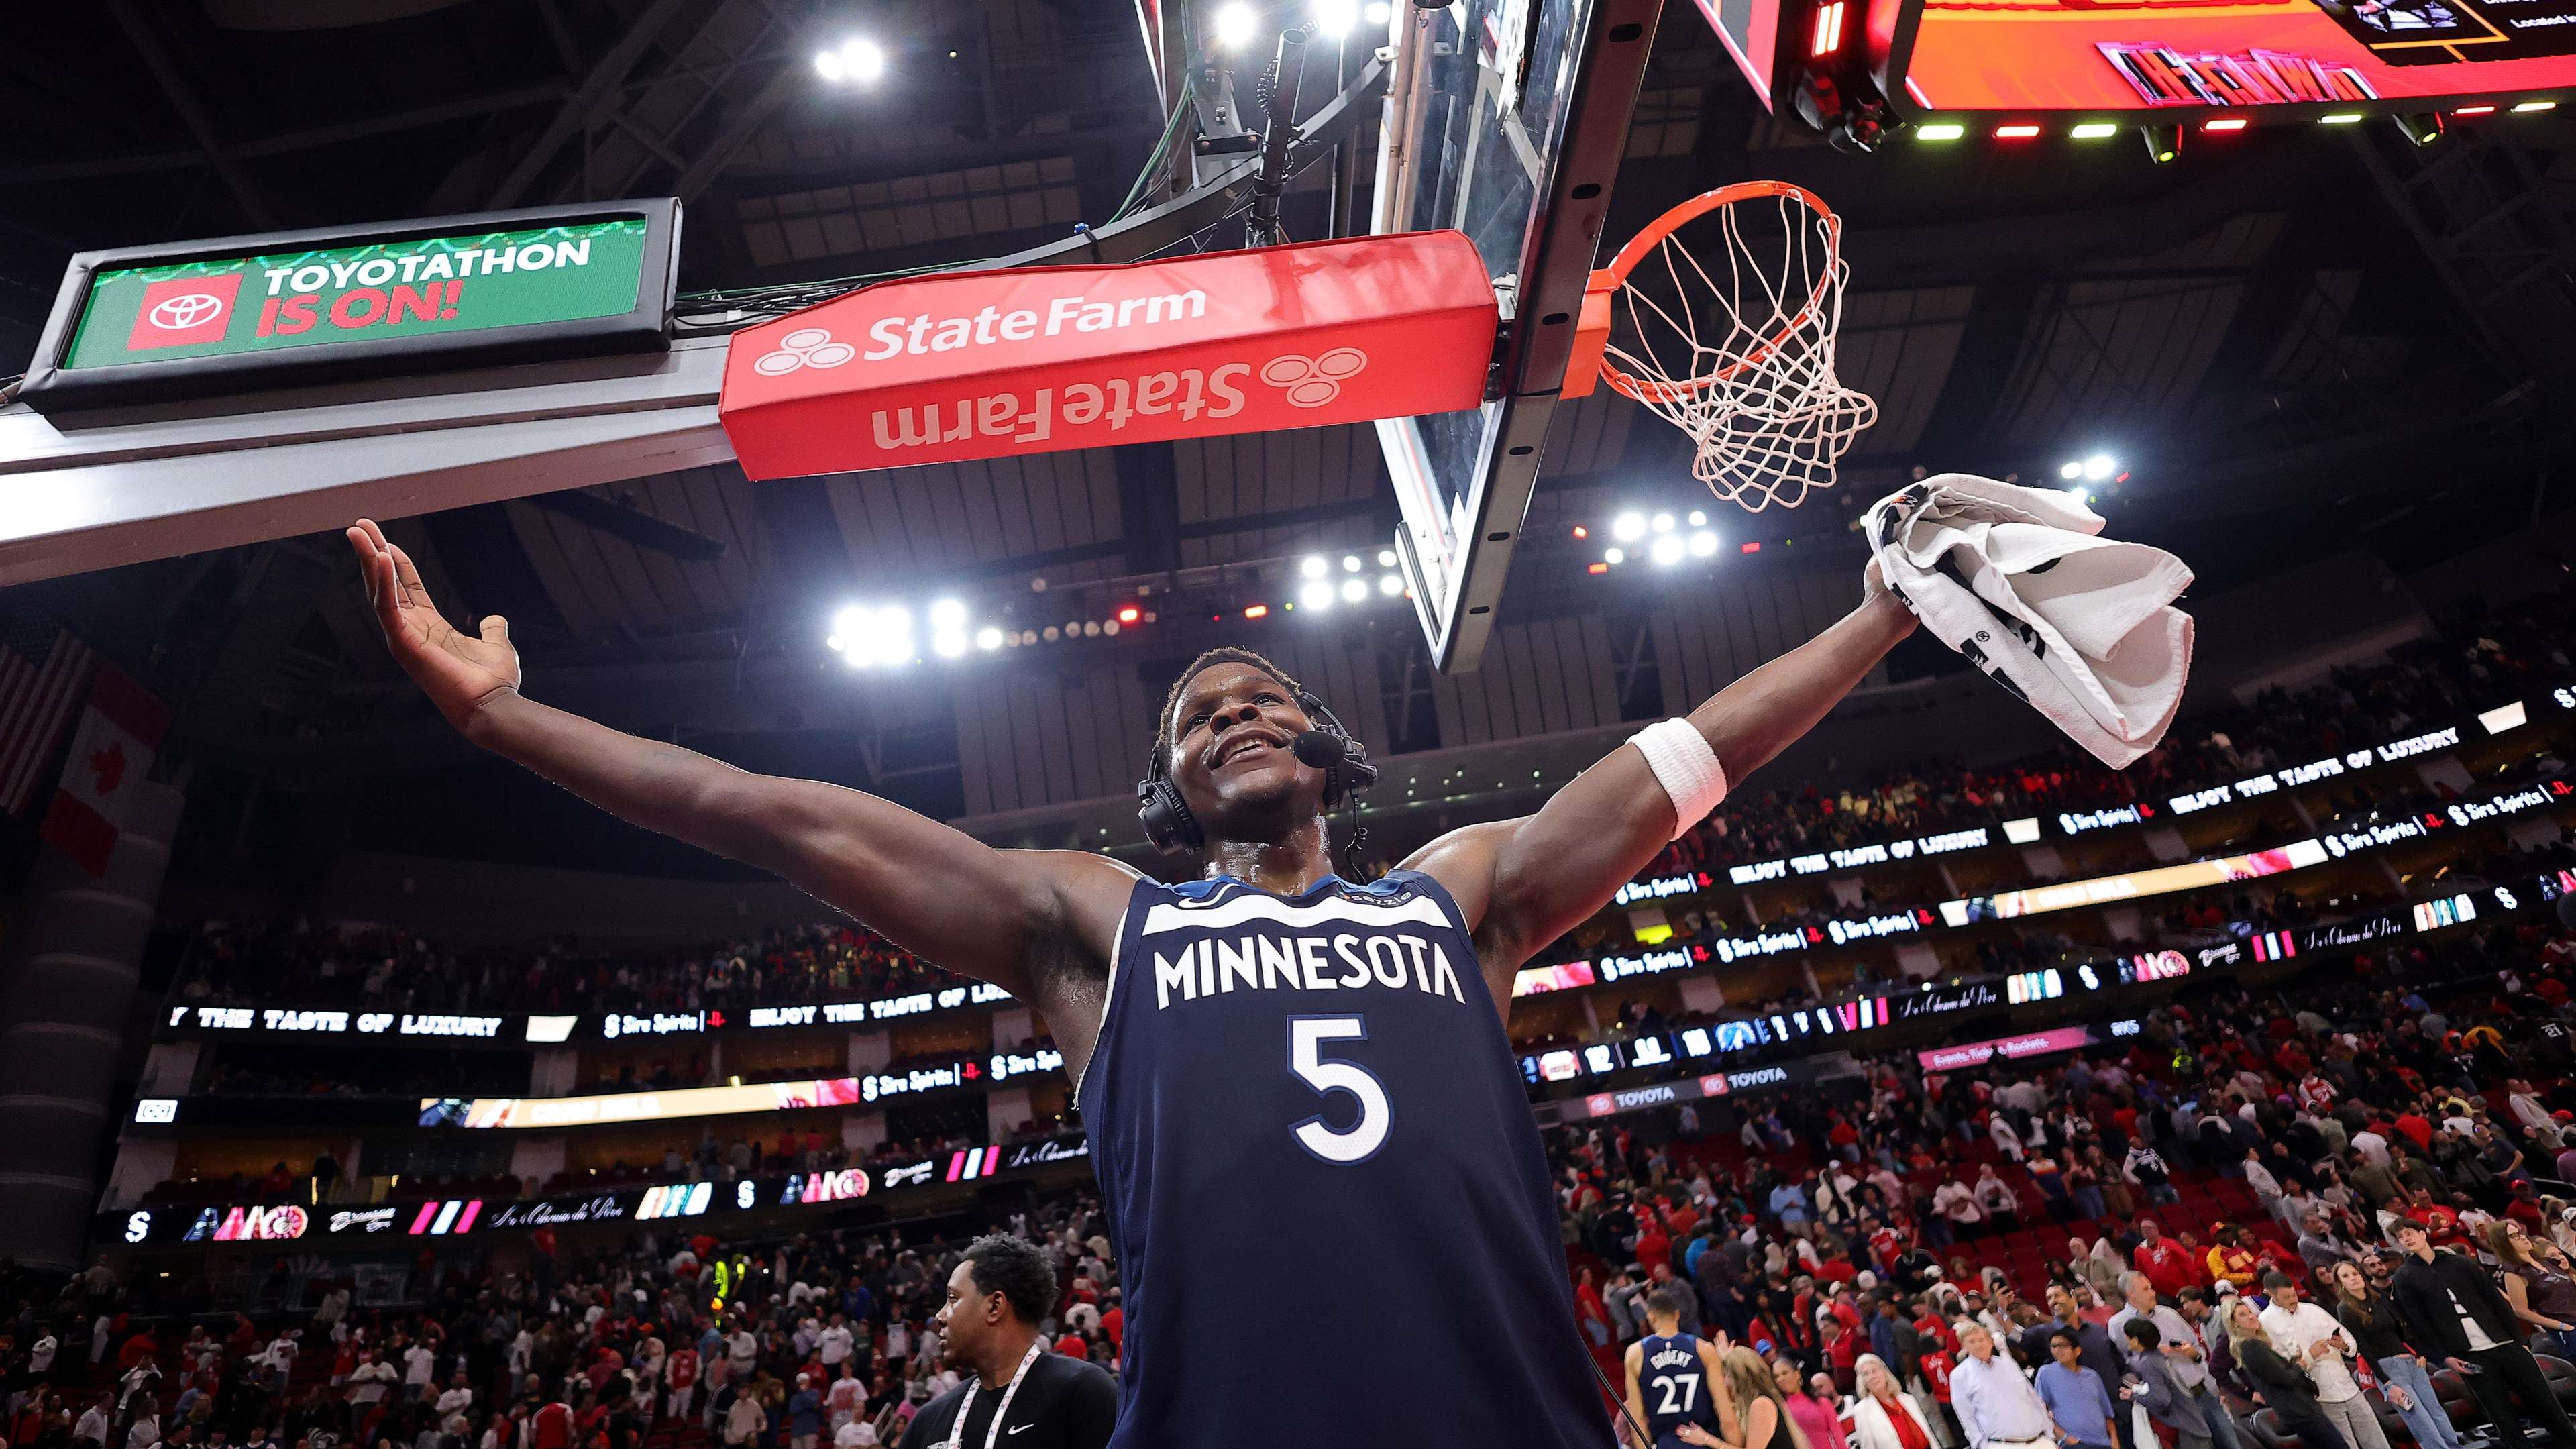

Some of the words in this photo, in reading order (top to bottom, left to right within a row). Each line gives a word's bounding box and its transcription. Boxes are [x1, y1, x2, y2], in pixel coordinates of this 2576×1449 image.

[264, 239, 591, 297] TOYOTATHON
[255, 293, 321, 338] IS
[329, 280, 464, 327] ON!
[863, 311, 1035, 362] State
[1043, 289, 1206, 337] Farm
[871, 386, 1052, 450] Farm
[1063, 363, 1251, 427] State
[2169, 786, 2231, 814] ENJOY
[2235, 775, 2277, 797] THE
[2279, 758, 2343, 786] TASTE
[2347, 750, 2372, 768] OF
[2377, 727, 2459, 761] LUXURY
[1730, 860, 1786, 884] ENJOY
[1790, 854, 1829, 874] THE
[1830, 845, 1888, 867] TASTE
[1890, 840, 1914, 858] OF
[1918, 828, 1988, 854] LUXURY
[1351, 892, 1412, 906] sezzle
[1153, 934, 1466, 1011] MINNESOTA
[198, 1008, 254, 1028] THE
[264, 1010, 349, 1031] TASTE
[357, 1014, 394, 1032] OF
[400, 1015, 502, 1036] LUXURY
[750, 1006, 816, 1026] ENJOY
[823, 1004, 864, 1022] THE
[870, 994, 932, 1018] TASTE
[938, 988, 965, 1007] OF
[1287, 1013, 1395, 1166] 5
[1615, 1086, 1676, 1108] TOYOTA
[1727, 1067, 1787, 1090] TOYOTA
[1652, 1373, 1700, 1415] 27
